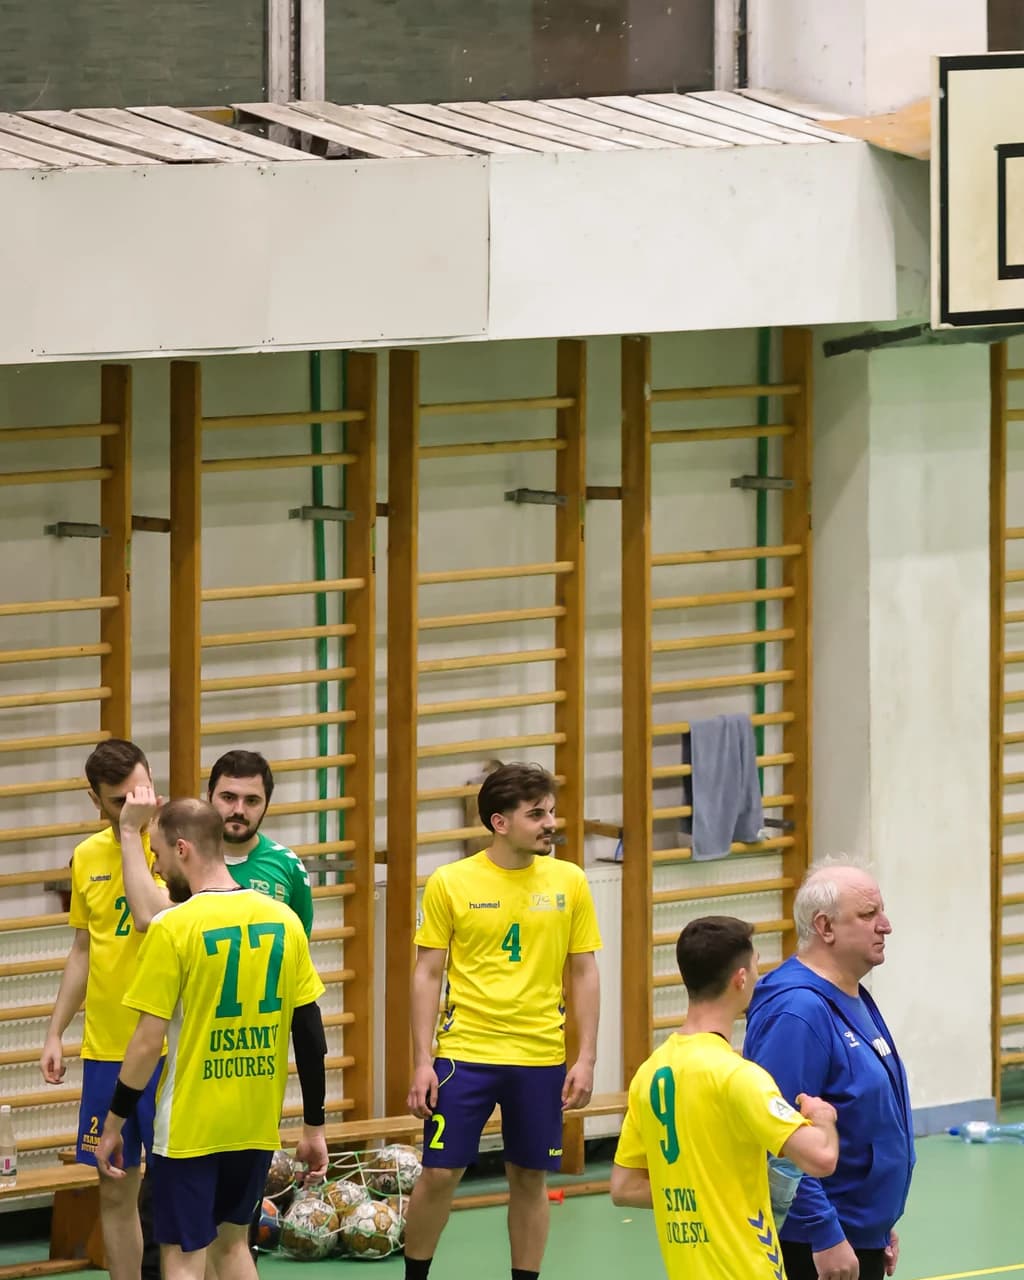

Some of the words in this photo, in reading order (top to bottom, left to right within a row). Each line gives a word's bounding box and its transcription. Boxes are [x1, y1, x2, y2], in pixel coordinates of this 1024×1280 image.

[115, 895, 131, 936] 2
[469, 900, 500, 909] hummel
[501, 923, 521, 962] 4
[202, 922, 285, 1018] 77
[90, 1116, 99, 1134] 2
[429, 1113, 446, 1149] 2
[650, 1066, 680, 1165] 9
